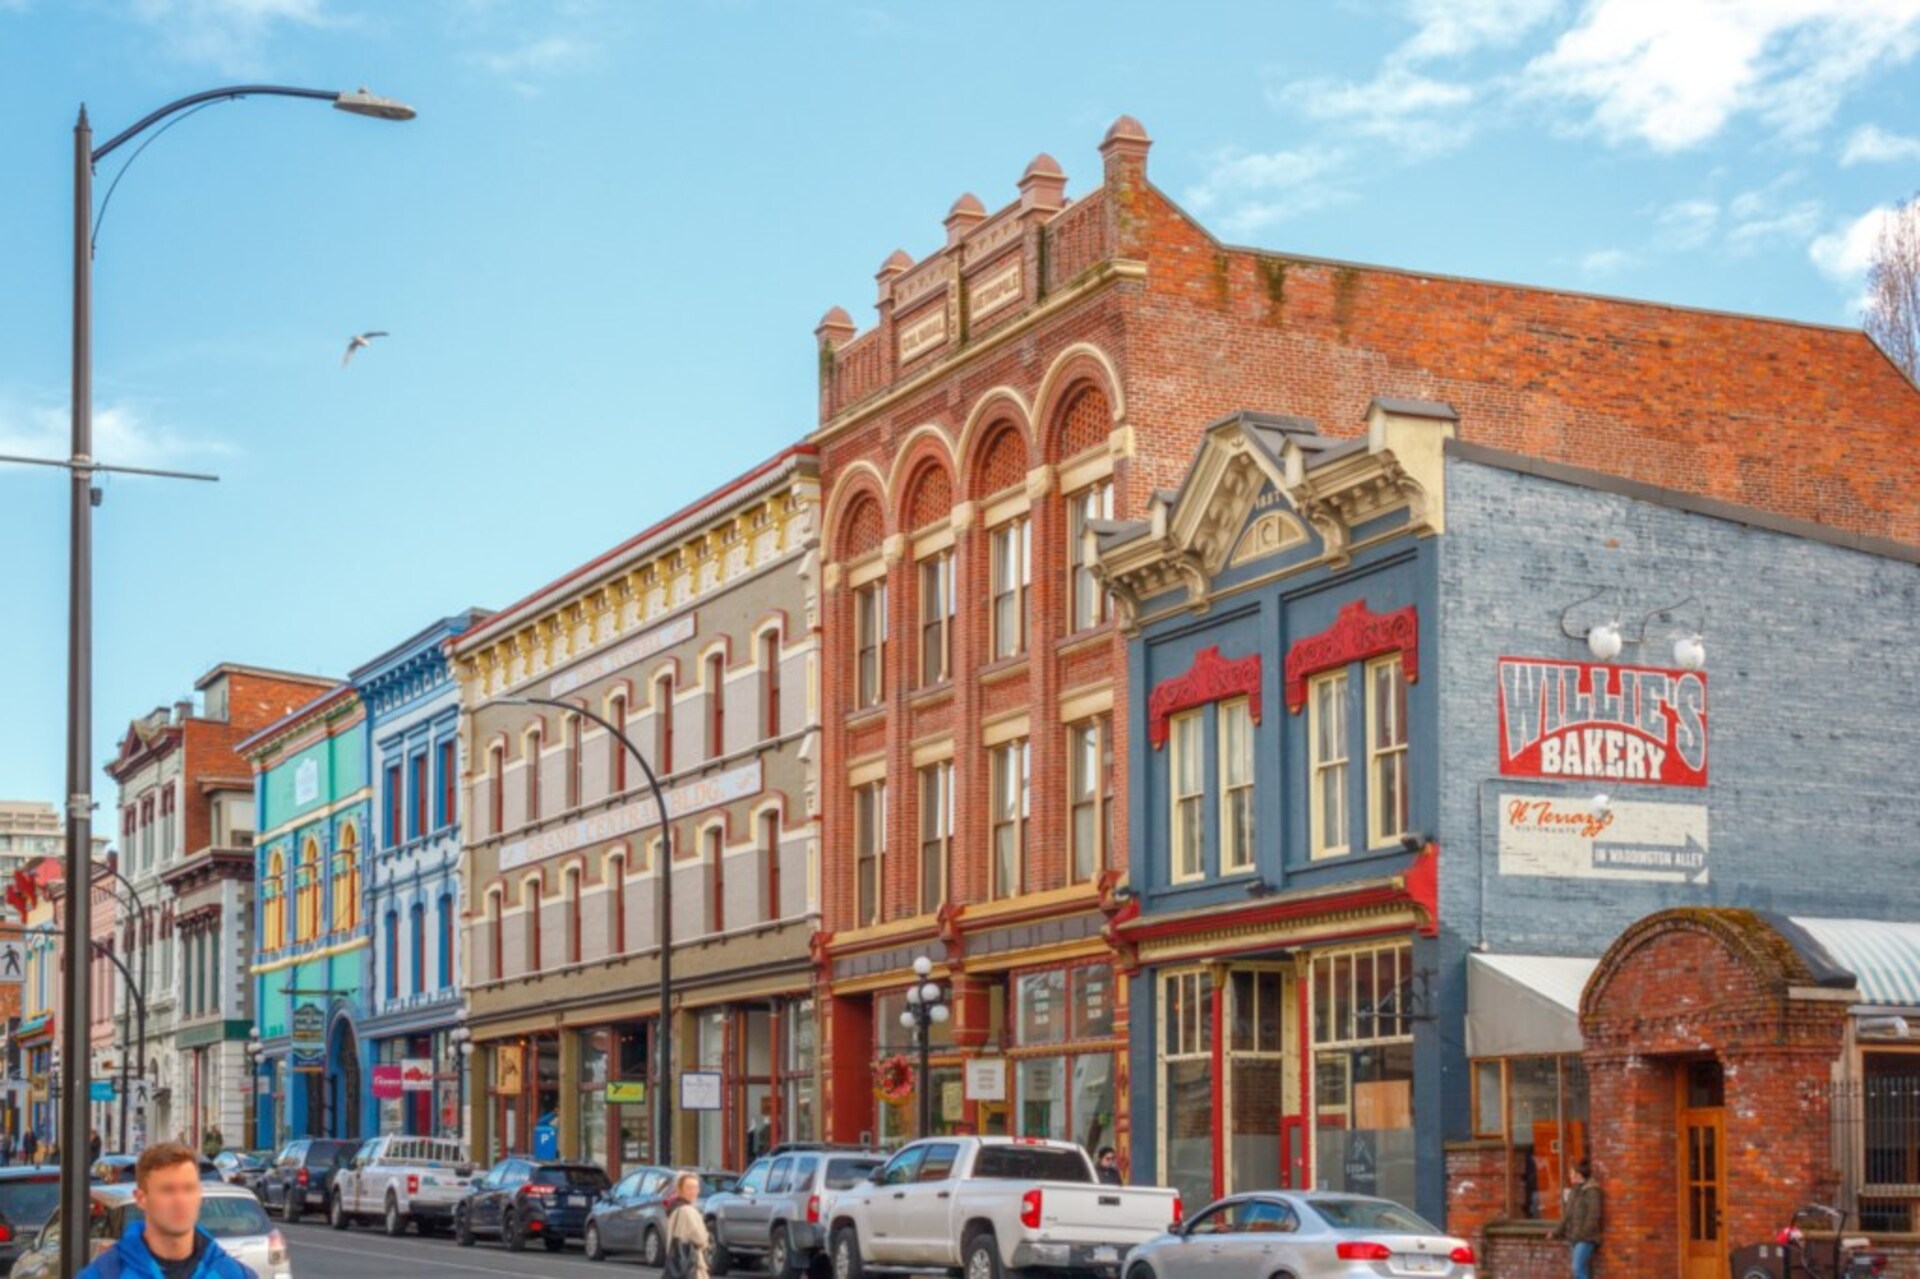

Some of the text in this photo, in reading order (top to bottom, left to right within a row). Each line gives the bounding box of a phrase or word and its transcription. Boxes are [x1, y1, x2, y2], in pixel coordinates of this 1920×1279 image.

[1500, 662, 1705, 771] WILLIE'S
[1541, 728, 1666, 780] BAKERY
[1674, 851, 1704, 867] ALLEY
